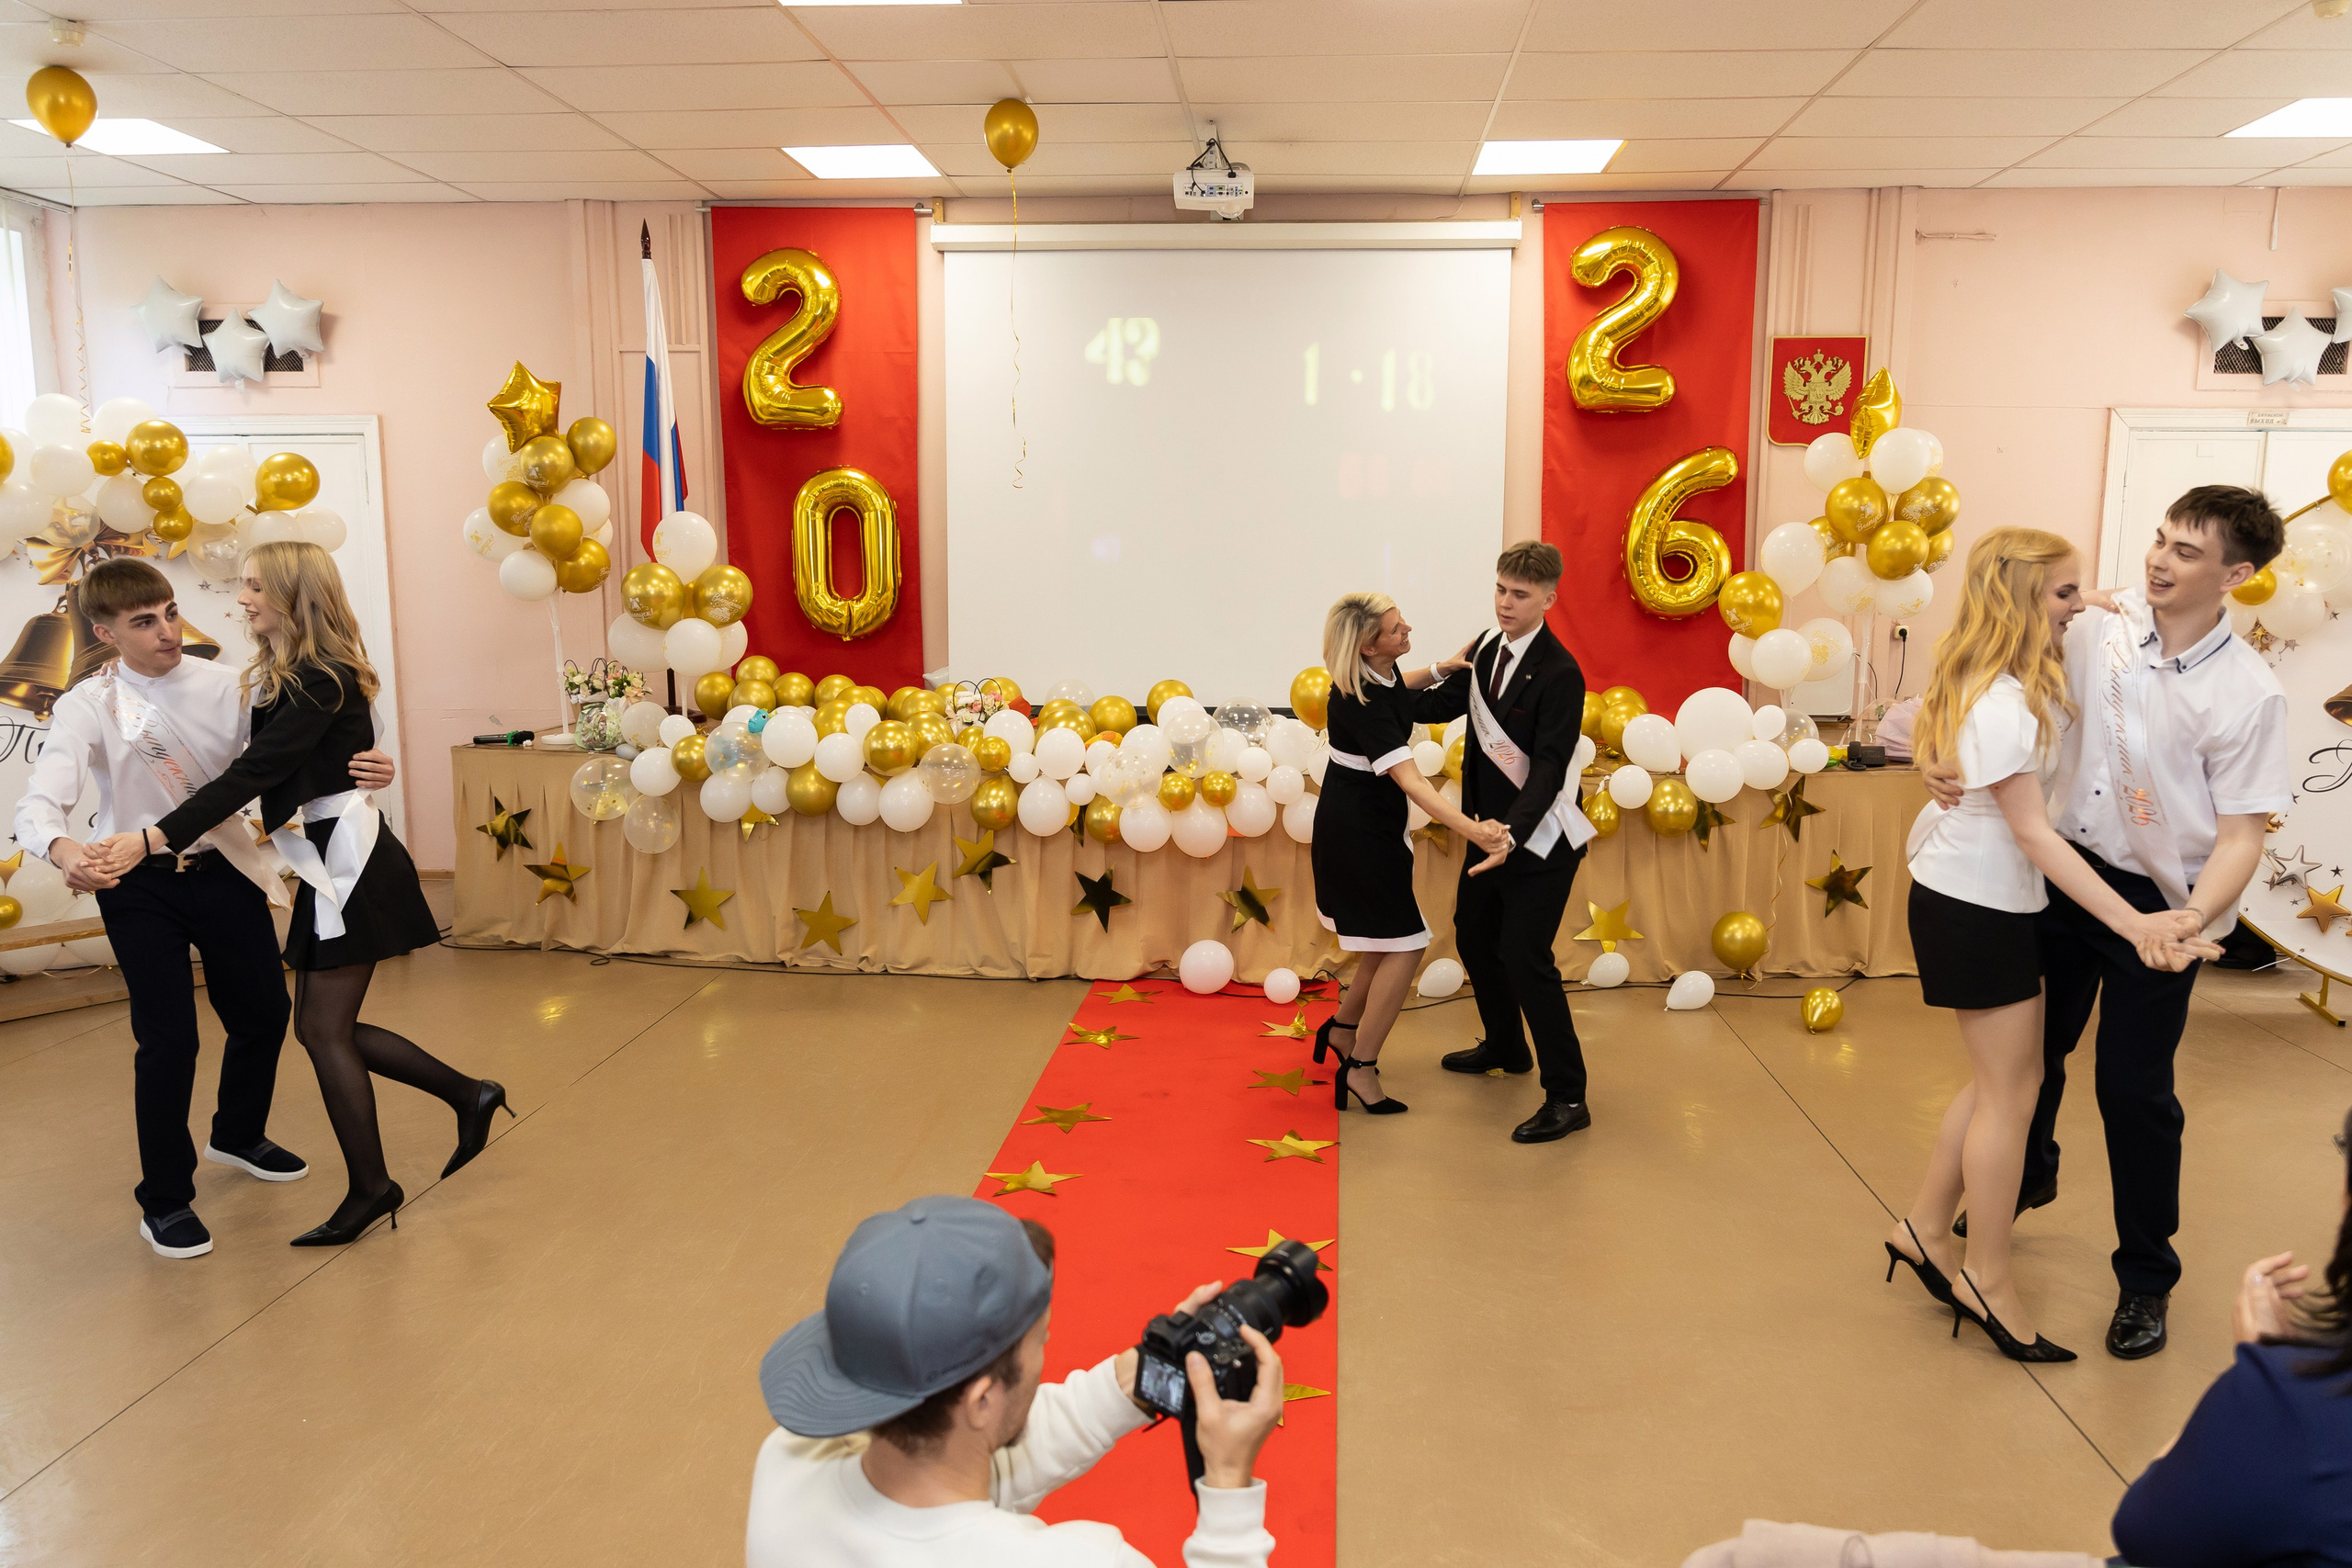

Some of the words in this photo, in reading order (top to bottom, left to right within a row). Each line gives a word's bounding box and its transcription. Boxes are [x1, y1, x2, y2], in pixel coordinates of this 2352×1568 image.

[741, 247, 844, 430] 2
[1566, 225, 1679, 413] 2
[791, 464, 902, 641] 0
[1622, 446, 1739, 620] 6
[1487, 739, 1521, 765] 2026
[2120, 784, 2161, 827] 2026
